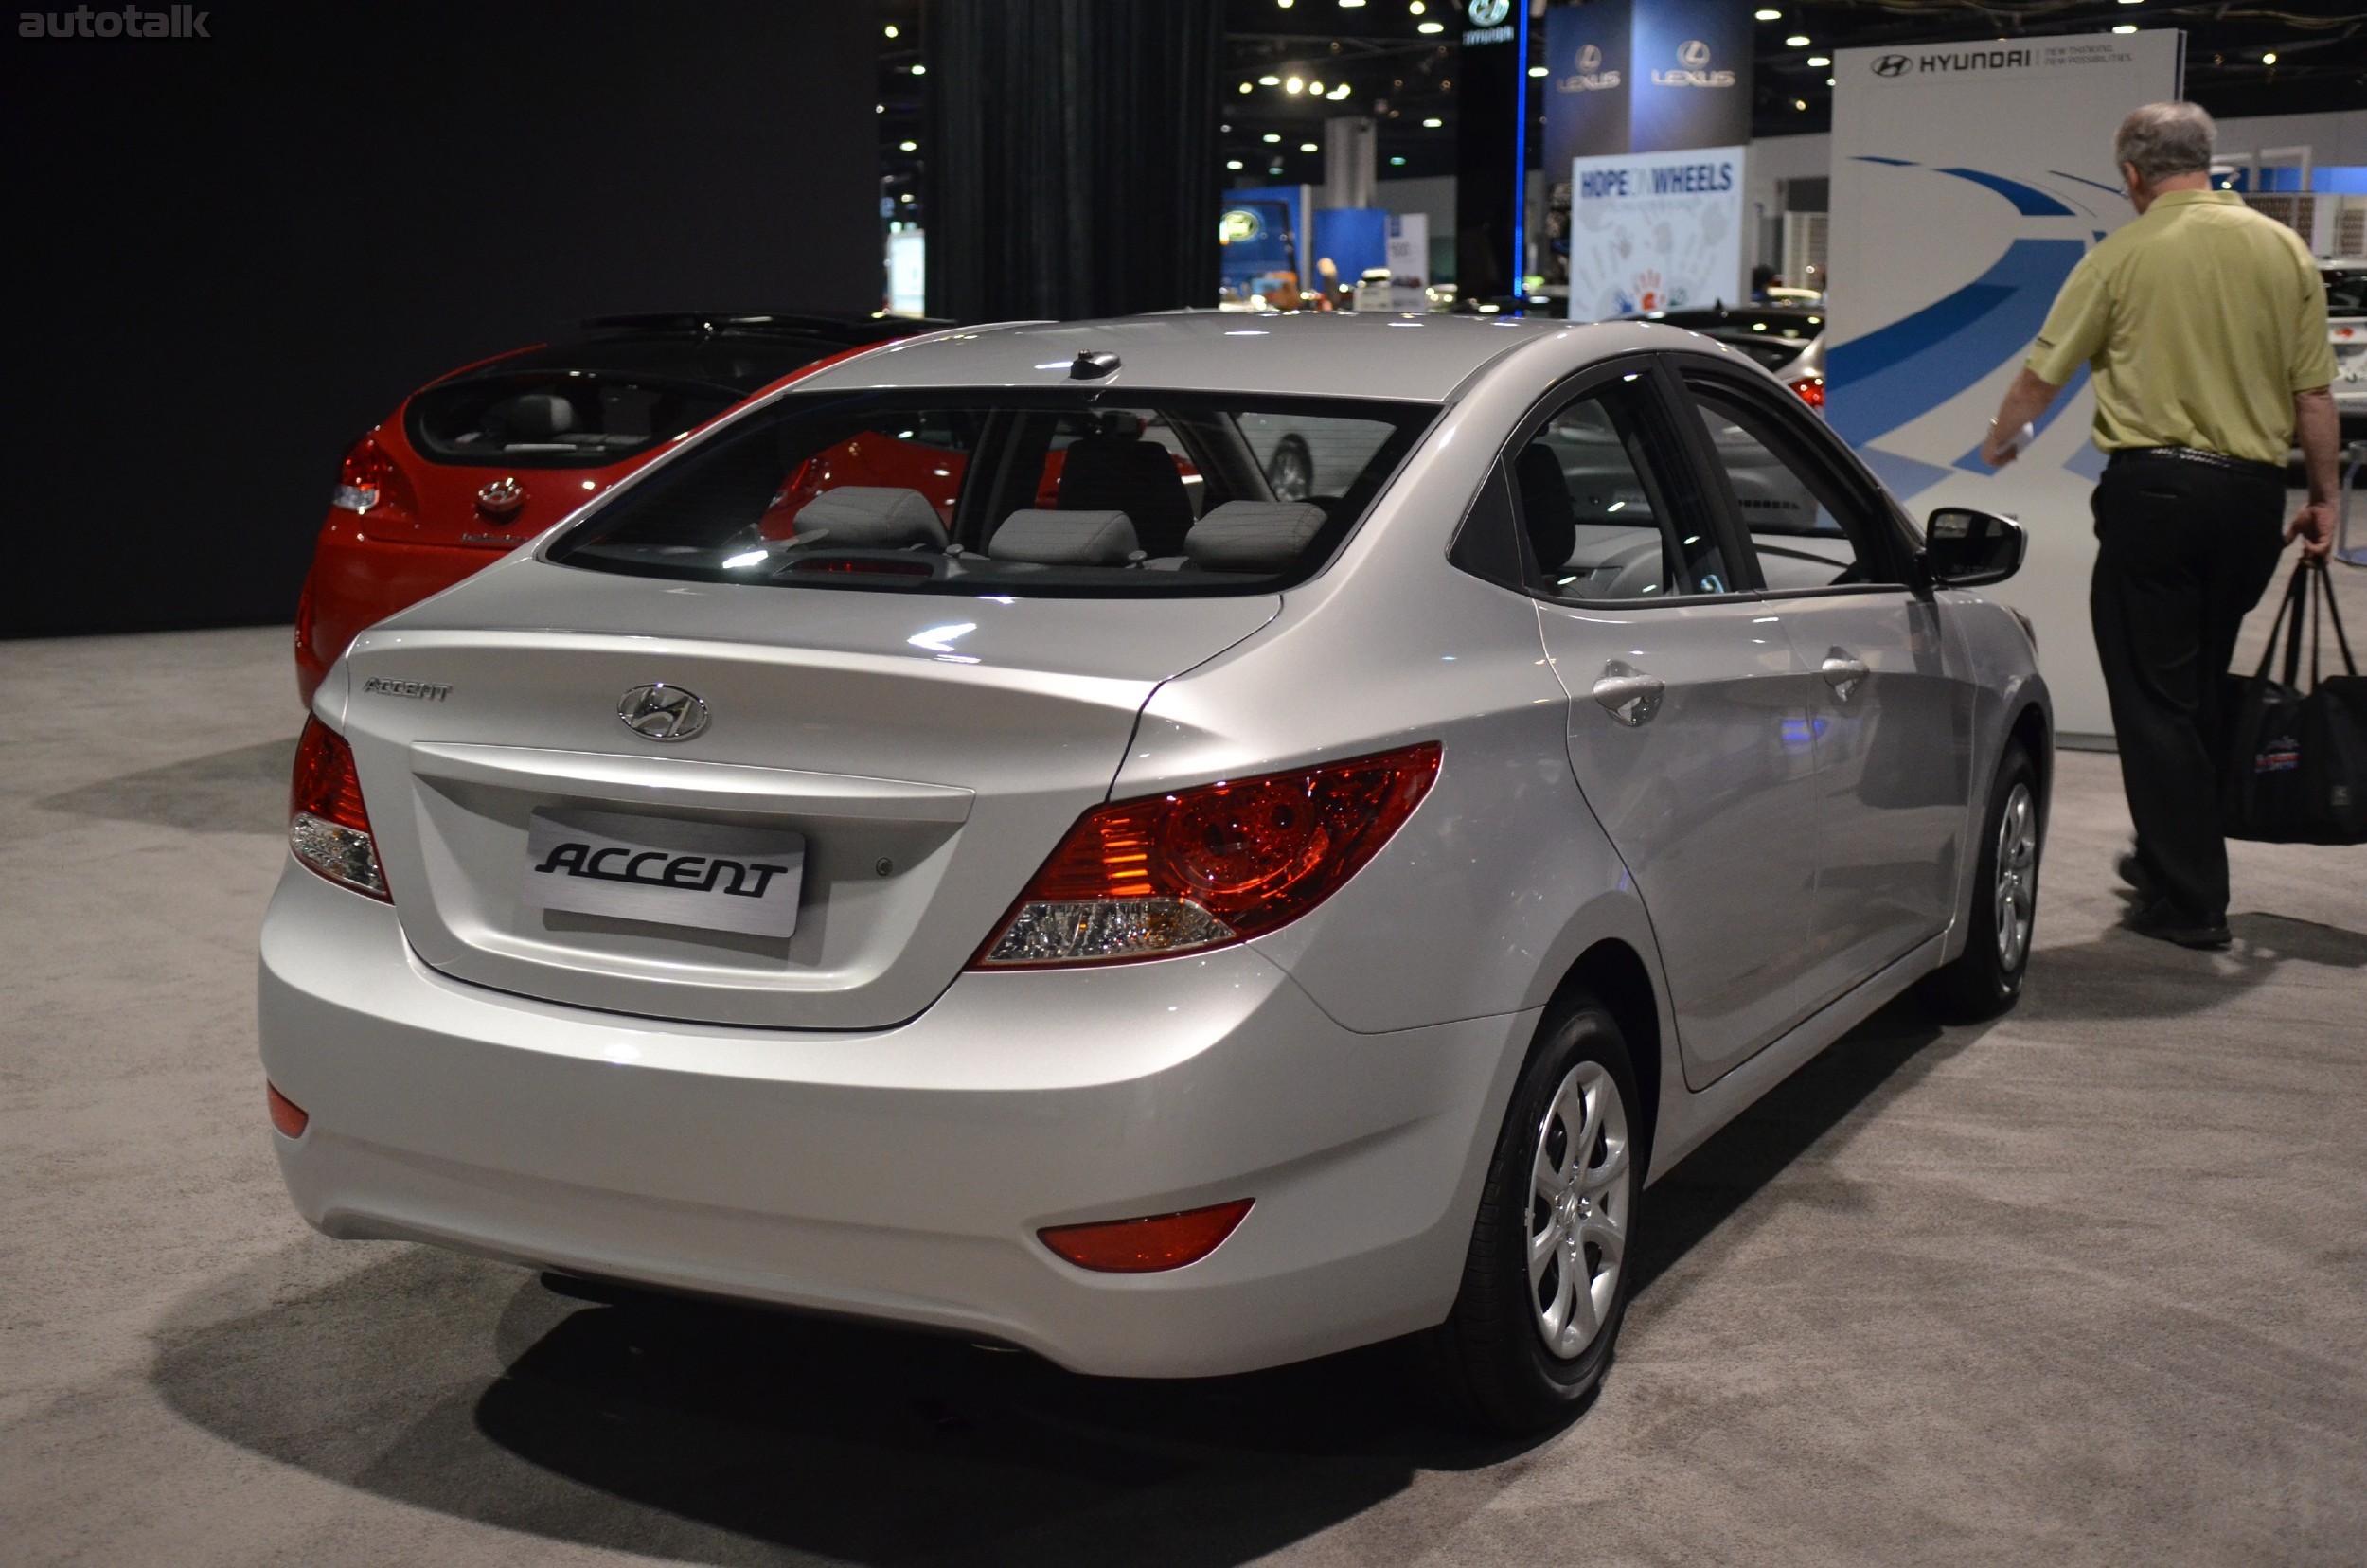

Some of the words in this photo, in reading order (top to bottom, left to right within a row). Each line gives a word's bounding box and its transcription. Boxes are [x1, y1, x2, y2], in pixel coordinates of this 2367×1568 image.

[1920, 50, 2031, 73] HYUNDAI
[1557, 70, 1621, 93] LEXUS
[1650, 69, 1735, 88] LEXUS
[1581, 170, 1628, 198] HOPE
[1652, 162, 1733, 195] WHEELS
[363, 676, 453, 703] ACCENT
[534, 842, 788, 899] ACCENT
